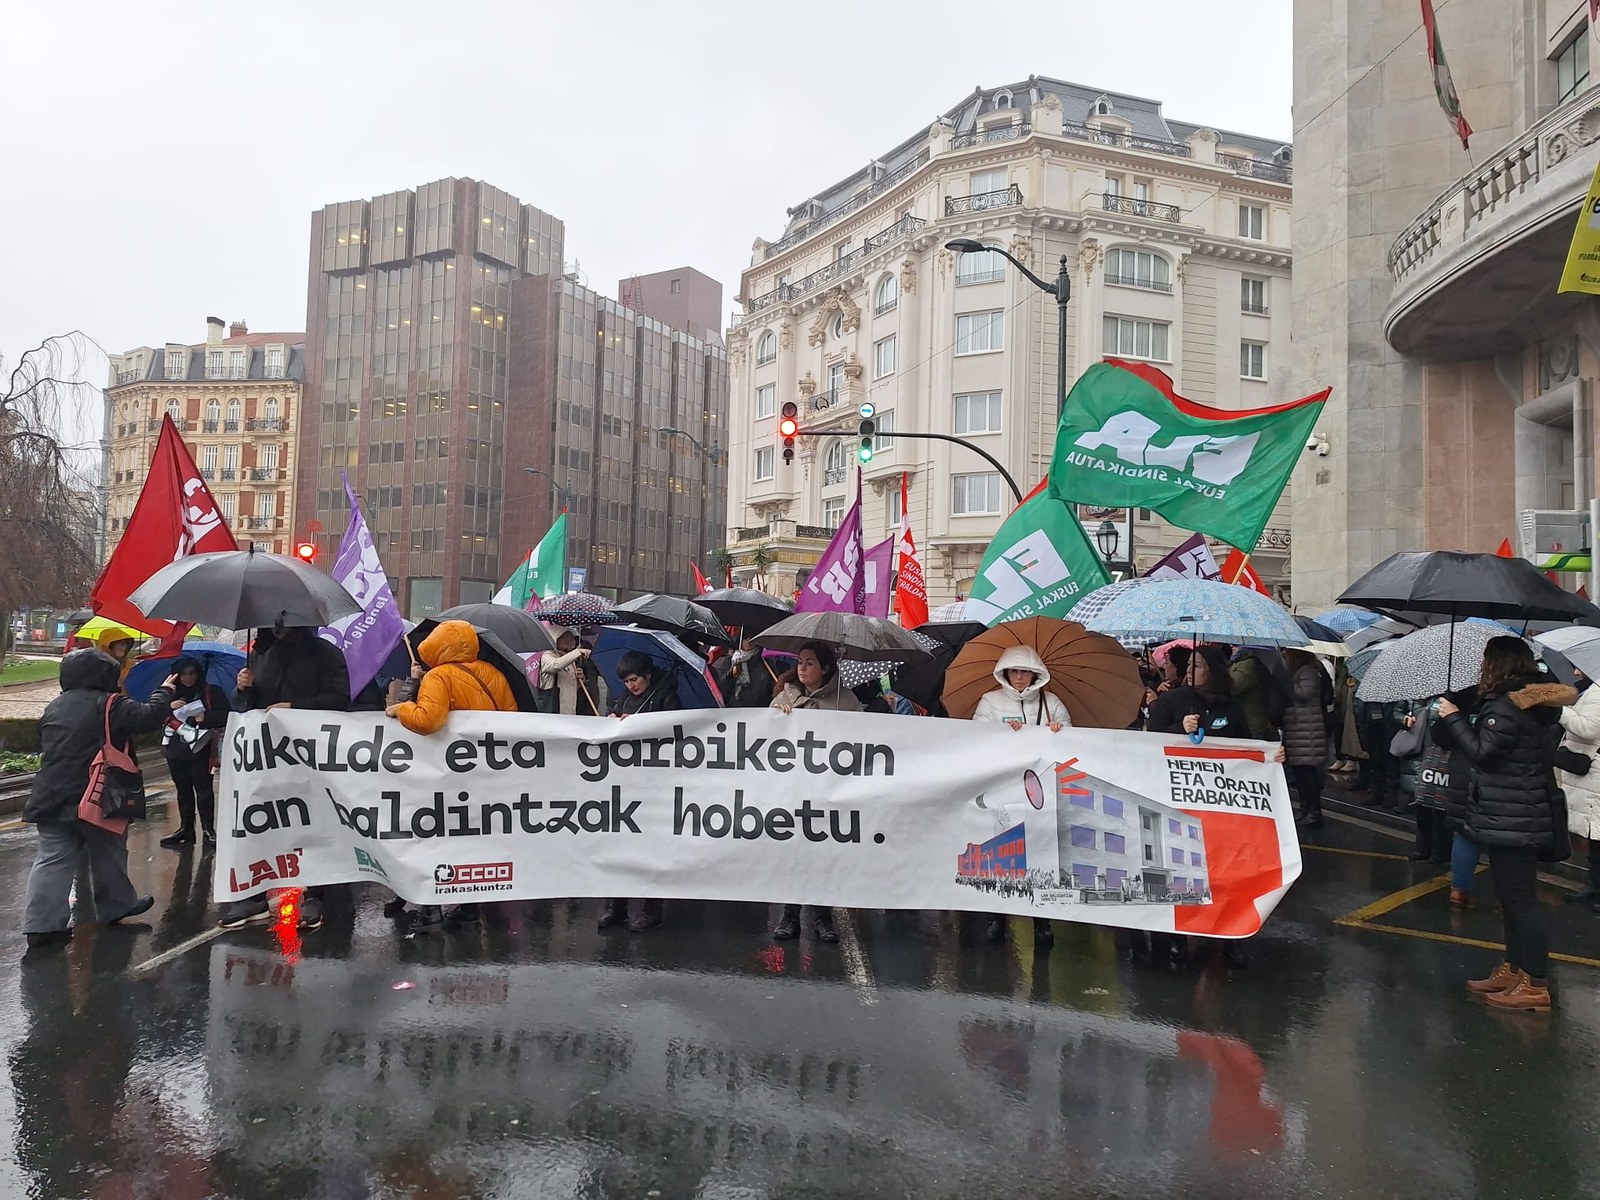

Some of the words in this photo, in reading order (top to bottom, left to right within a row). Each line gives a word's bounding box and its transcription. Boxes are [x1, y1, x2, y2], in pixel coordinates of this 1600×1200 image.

[232, 722, 414, 774] Sukalde
[445, 732, 546, 774] eta
[577, 721, 895, 782] garbiketan
[1166, 758, 1225, 774] HEMEN
[1170, 771, 1205, 787] ETA
[1214, 776, 1271, 796] ORAIN
[231, 790, 311, 839] lan
[325, 785, 643, 840] baldintzak
[672, 786, 886, 845] hobetu.
[229, 852, 300, 893] LAB
[457, 865, 510, 881] CCOO
[435, 883, 513, 895] irakaskuntza
